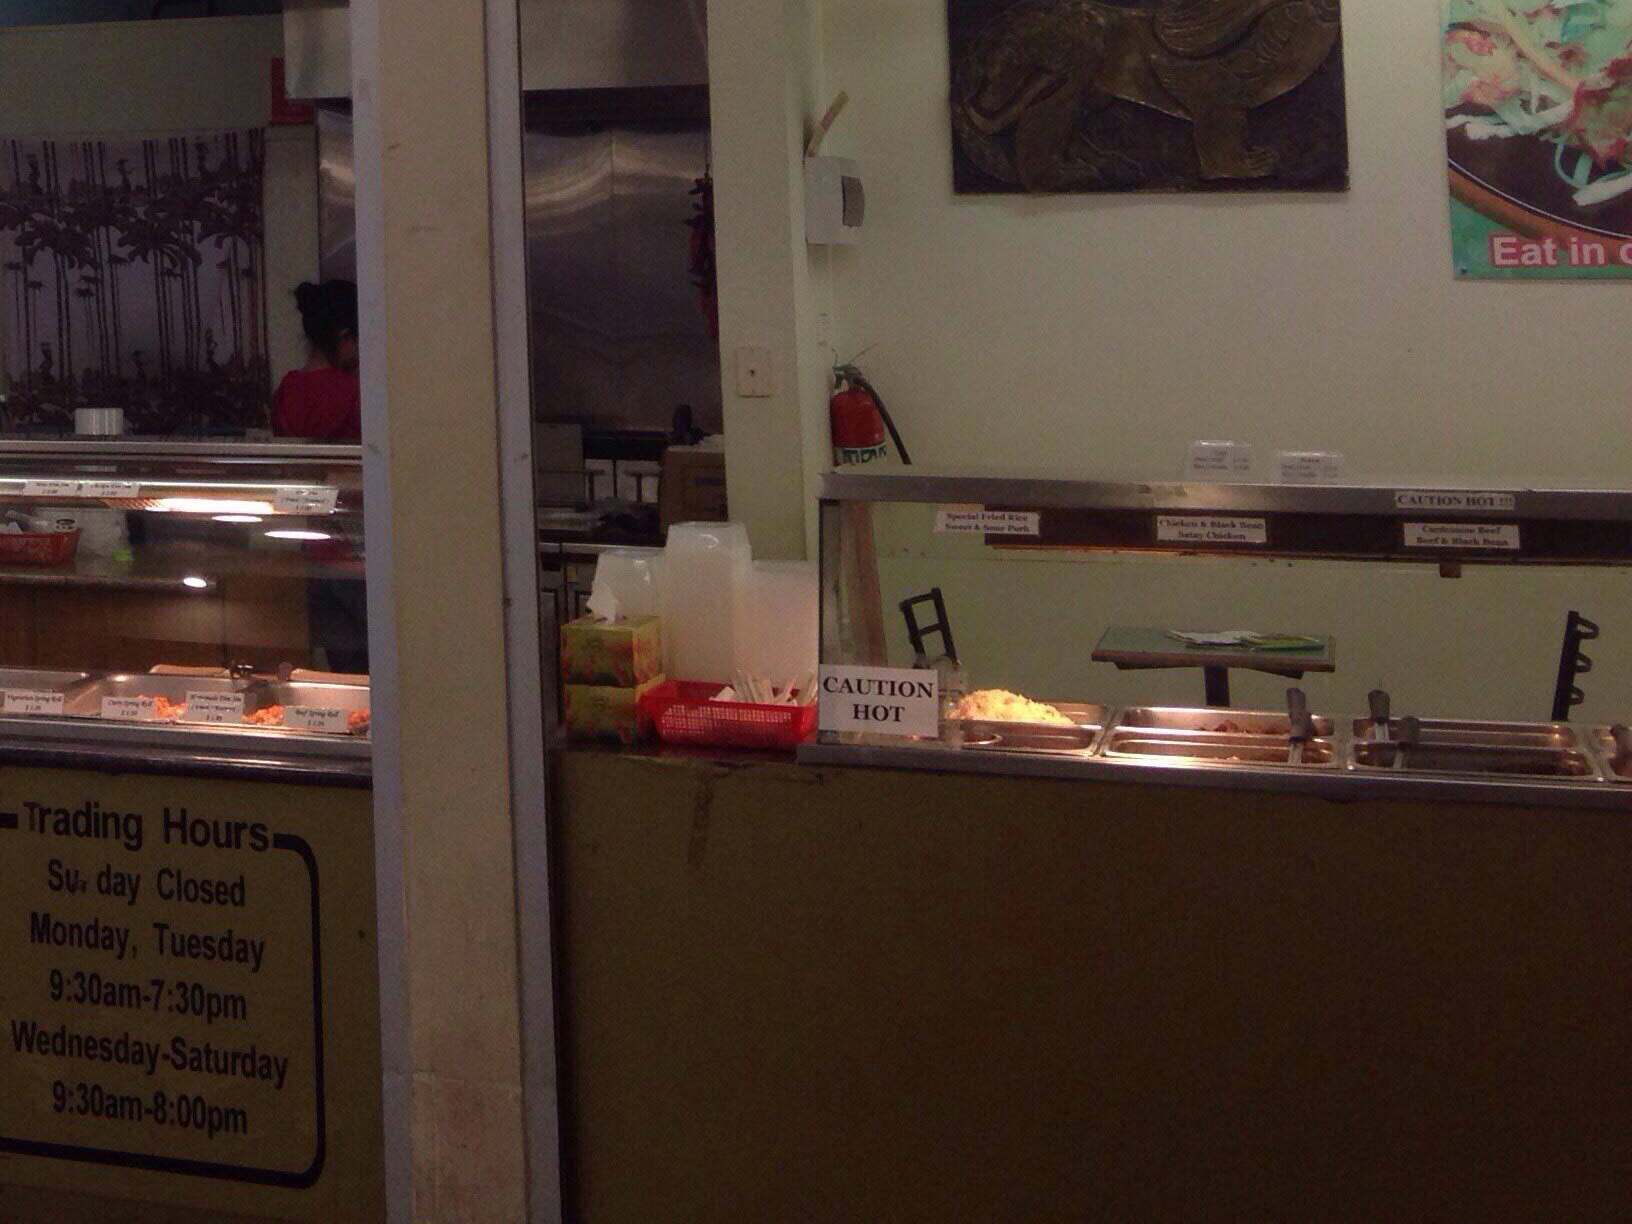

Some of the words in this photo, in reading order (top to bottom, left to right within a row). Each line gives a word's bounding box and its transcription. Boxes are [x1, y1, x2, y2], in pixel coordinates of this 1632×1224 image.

[1492, 236, 1558, 266] Eat
[1570, 236, 1606, 265] in
[1397, 495, 1462, 506] CAUTION
[1466, 496, 1496, 506] HOT
[823, 676, 934, 698] CAUTION
[853, 703, 905, 722] HOT
[23, 801, 143, 851] Trading
[163, 807, 270, 852] Hours
[157, 868, 246, 907] Closed
[30, 911, 138, 960] Monday,
[153, 922, 264, 973] Tuesday
[50, 968, 247, 1024] 9:30am-7:30pm
[11, 1019, 289, 1091] Wednesday-Saturday
[52, 1080, 248, 1140] 9:30am-8:00pm
